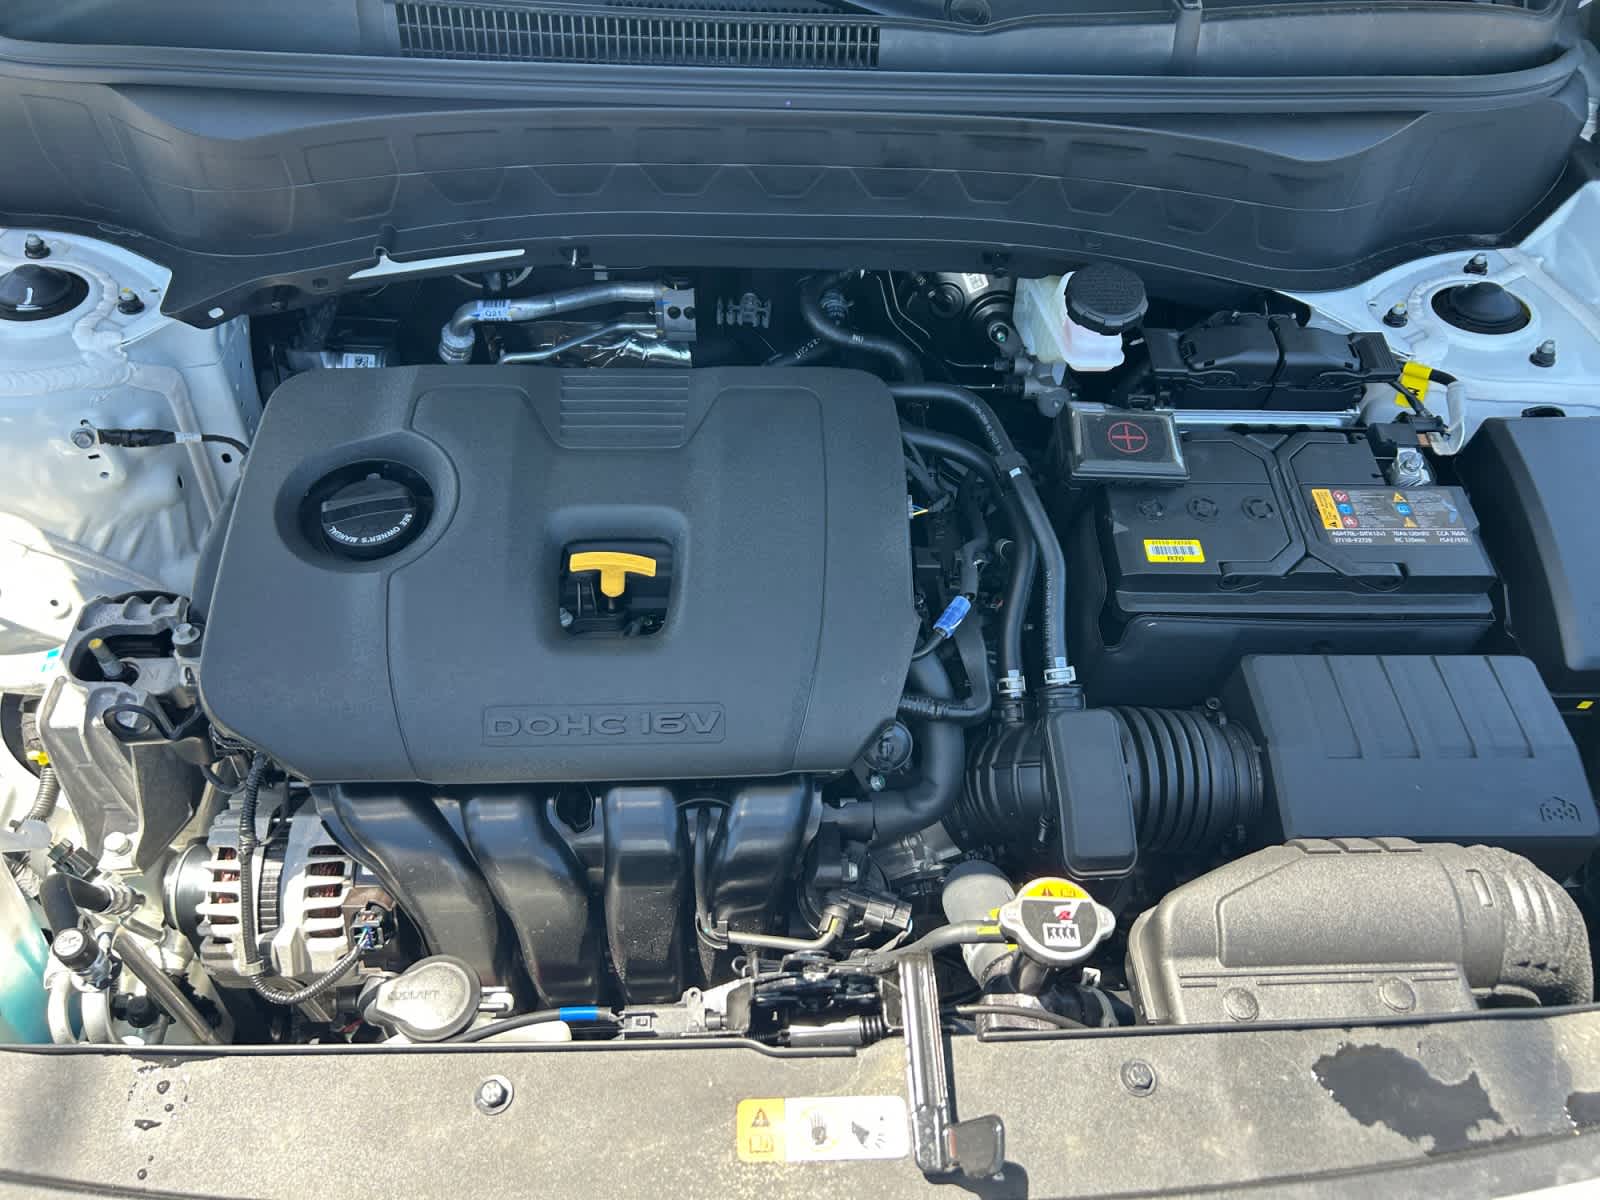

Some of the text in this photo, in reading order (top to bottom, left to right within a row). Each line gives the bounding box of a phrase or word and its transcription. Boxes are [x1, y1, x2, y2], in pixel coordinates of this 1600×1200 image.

[328, 513, 413, 544] SEE OWNER'S MANUAL
[487, 710, 722, 737] DOHC 16V
